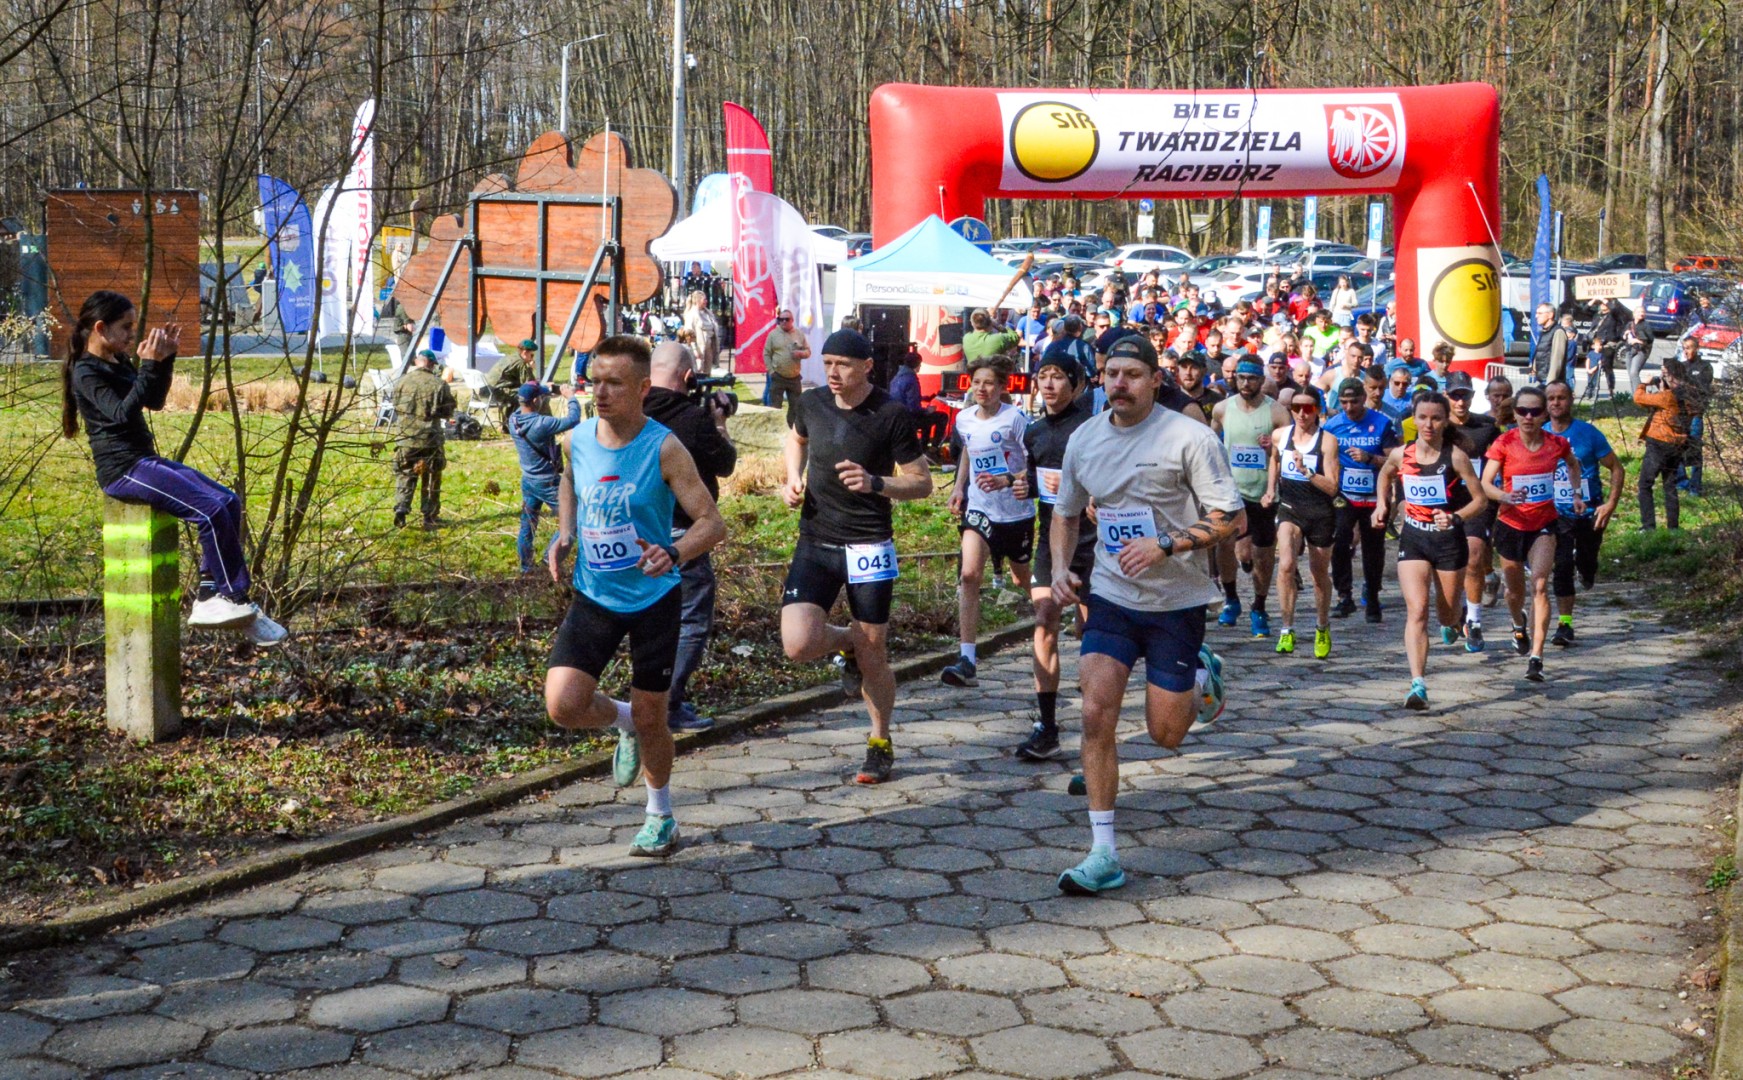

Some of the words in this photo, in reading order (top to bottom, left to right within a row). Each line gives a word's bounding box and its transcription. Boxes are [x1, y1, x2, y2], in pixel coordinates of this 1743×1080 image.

[1173, 103, 1240, 119] BIEG
[1050, 112, 1096, 129] SIR
[1118, 131, 1301, 152] TWARDZIELA
[1132, 159, 1282, 182] RACIBÓRZ
[865, 283, 929, 294] PersonalBest
[1586, 277, 1618, 286] VAMOS
[975, 456, 997, 469] 037
[1236, 453, 1259, 463] 023
[1347, 476, 1369, 486] 046
[1410, 486, 1437, 497] 090
[581, 483, 636, 518] NEVER
[585, 505, 622, 529] GIVE
[1109, 525, 1145, 542] 055
[592, 542, 627, 559] 120
[858, 553, 892, 571] 043
